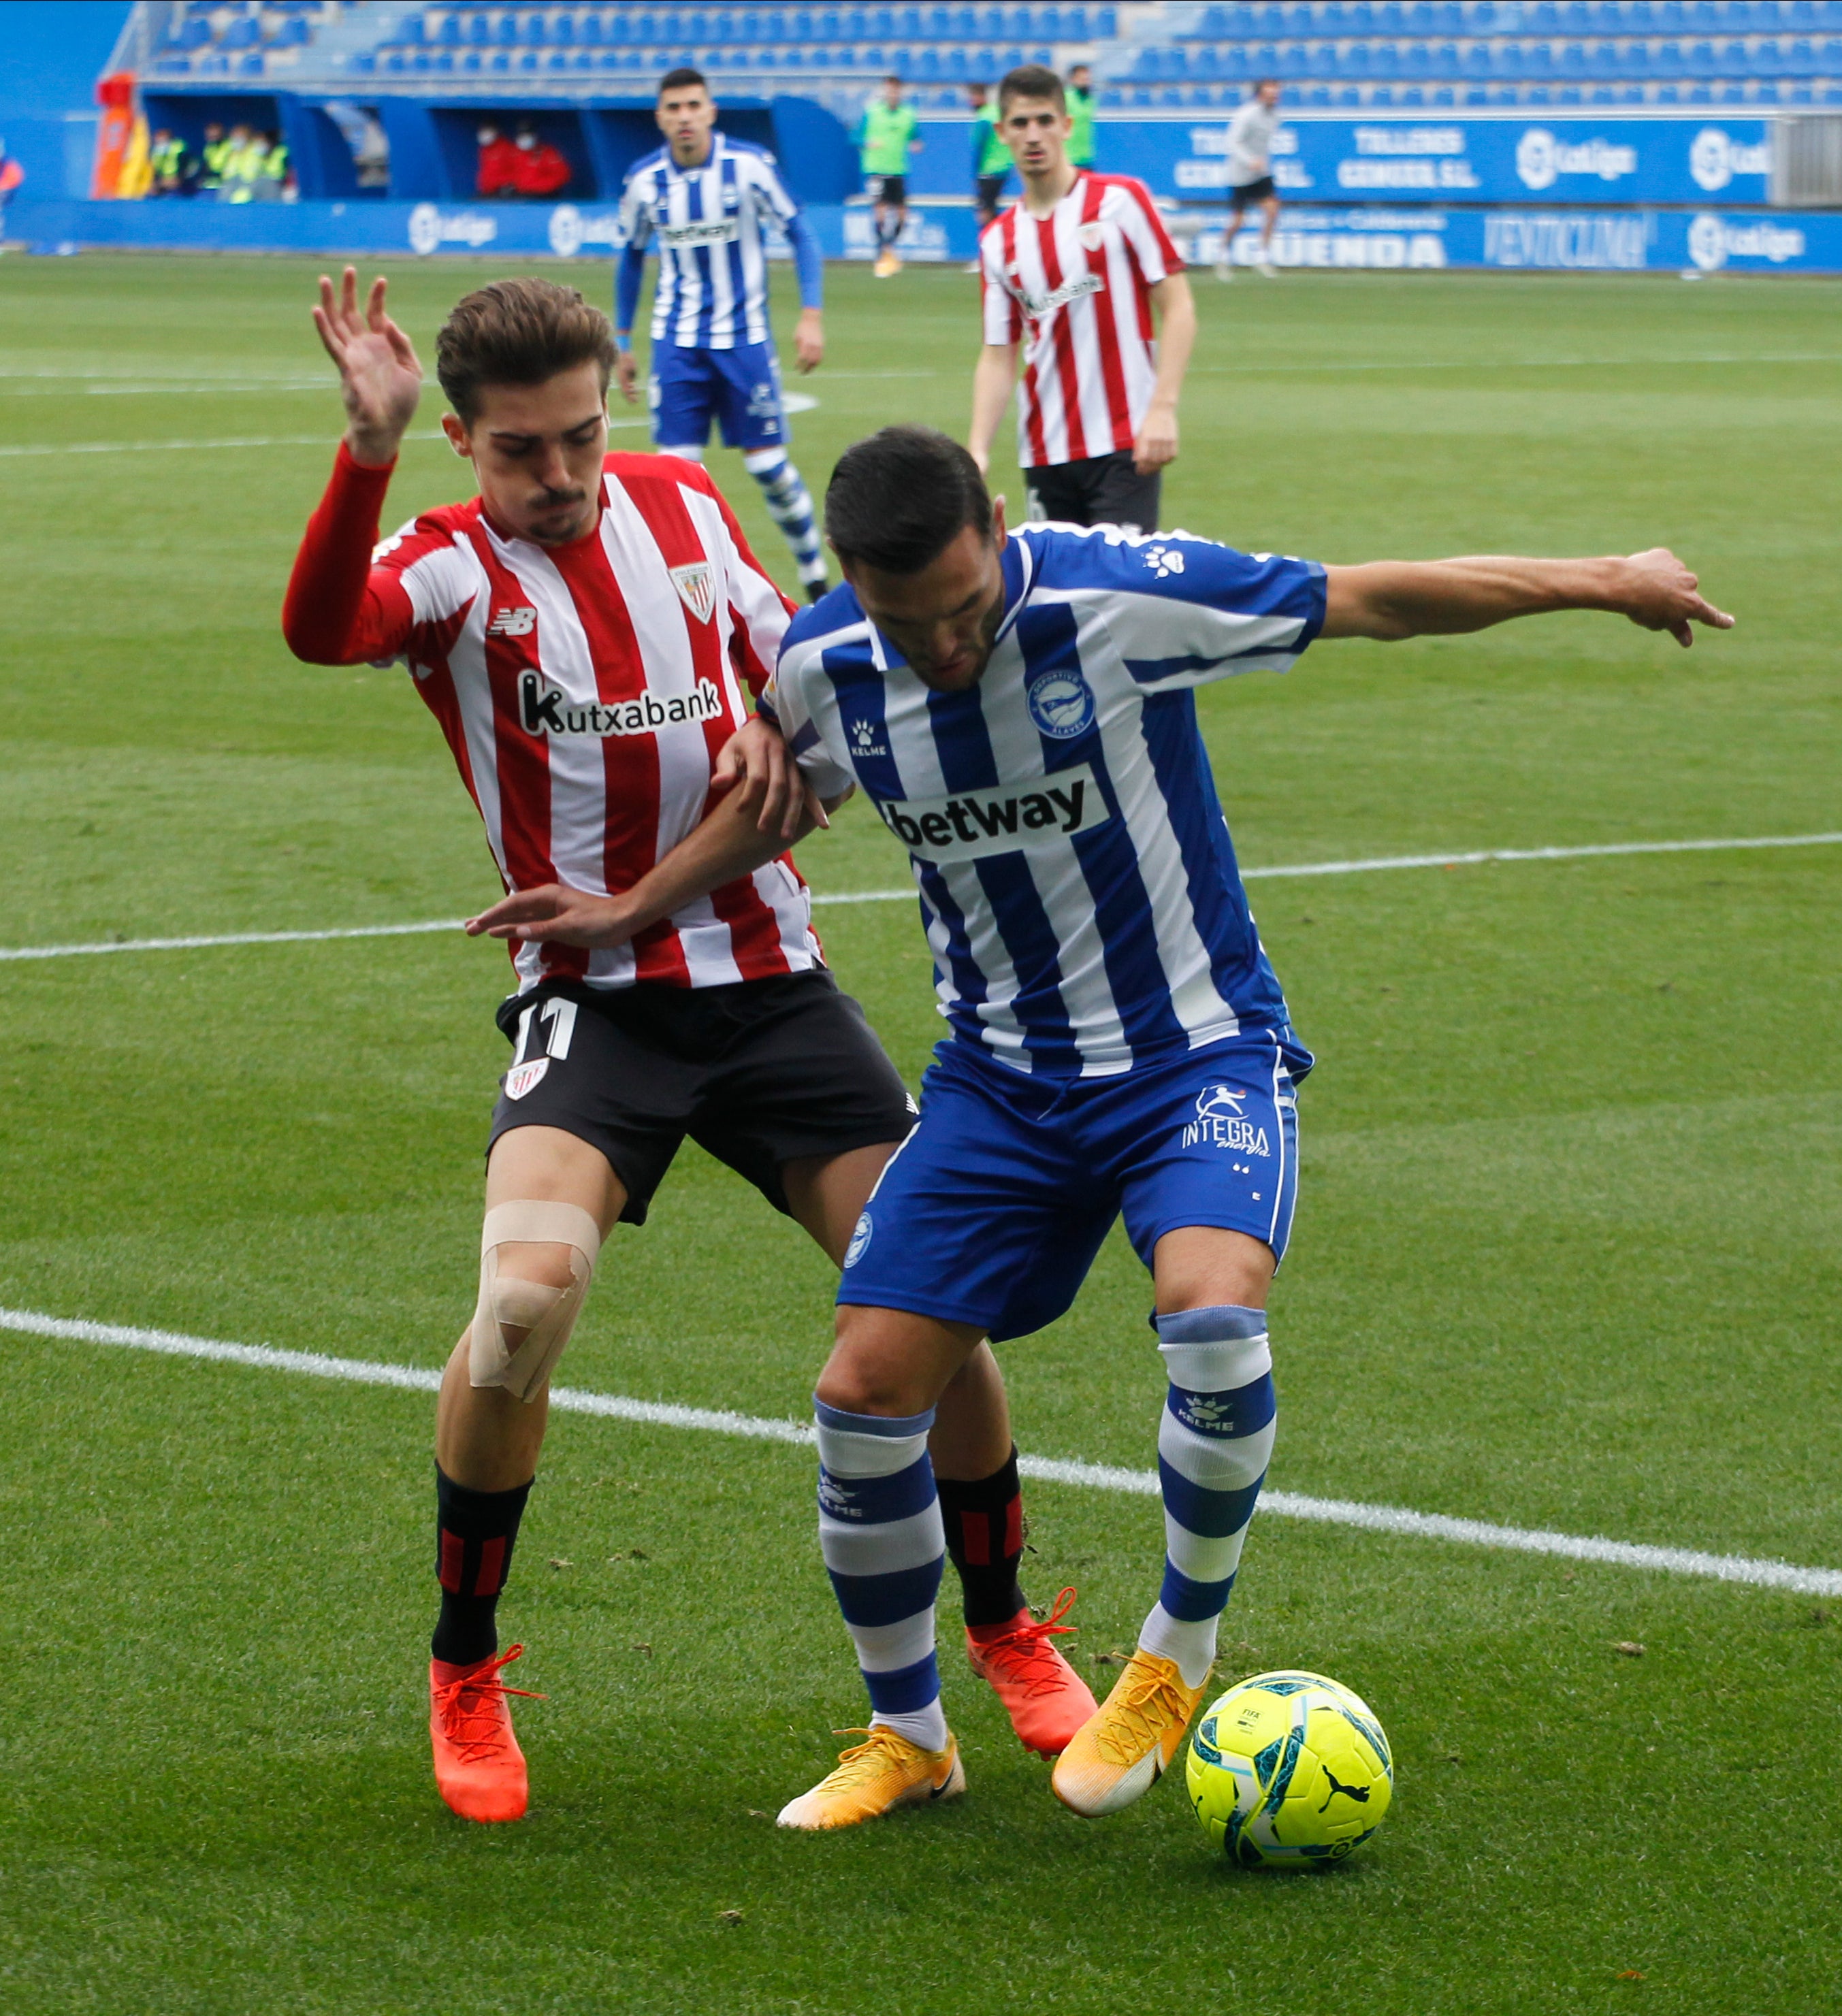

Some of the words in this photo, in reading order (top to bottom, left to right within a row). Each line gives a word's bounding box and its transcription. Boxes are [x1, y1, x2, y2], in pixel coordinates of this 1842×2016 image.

[522, 673, 720, 734] Kutxabank
[852, 746, 886, 757] KELME
[886, 779, 1085, 847] betway
[1182, 1118, 1270, 1151] INTEGRA
[1178, 1408, 1234, 1431] KELME
[1242, 1708, 1259, 1719] FIFA
